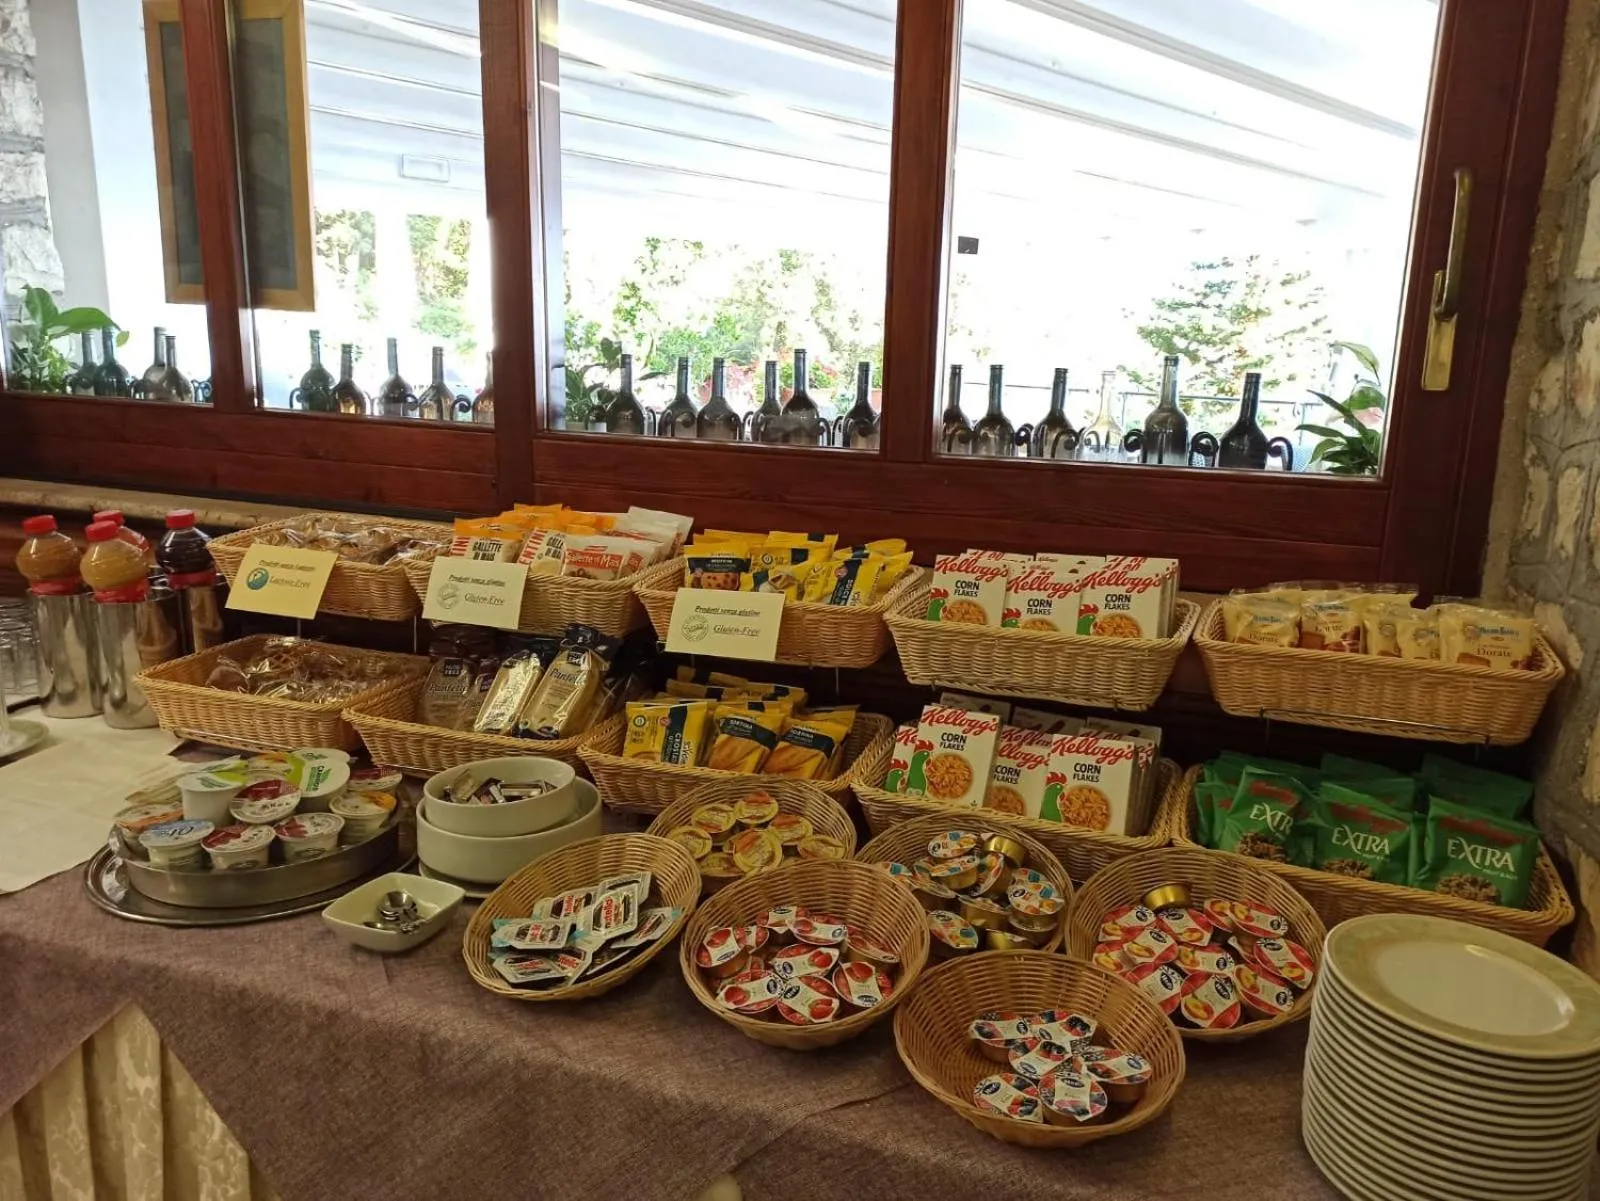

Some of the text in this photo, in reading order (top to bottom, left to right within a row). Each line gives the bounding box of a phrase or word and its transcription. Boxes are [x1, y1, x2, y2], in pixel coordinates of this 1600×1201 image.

[935, 557, 1009, 582] Kellogg's
[955, 579, 980, 591] CORN
[1008, 575, 1083, 599] Kellogg's
[1083, 571, 1162, 595] Kellogg's
[954, 588, 978, 598] FLAKES
[1104, 593, 1132, 604] CORN
[1027, 598, 1053, 610] CORN
[1104, 602, 1131, 612] FLAKES
[1026, 607, 1052, 616] FLAKES
[921, 706, 999, 736] Kellogg's
[941, 732, 968, 744] CORN
[940, 742, 965, 751] FLAKES
[1052, 737, 1134, 765] Kellogg's
[995, 765, 1021, 777] CORN
[1074, 763, 1102, 774] CORN
[993, 774, 1019, 784] FLAKES
[1073, 773, 1100, 783] FLAKES
[1250, 802, 1294, 835] EXTR
[1332, 824, 1390, 856] EXTRA
[1447, 836, 1515, 872] EXTRA
